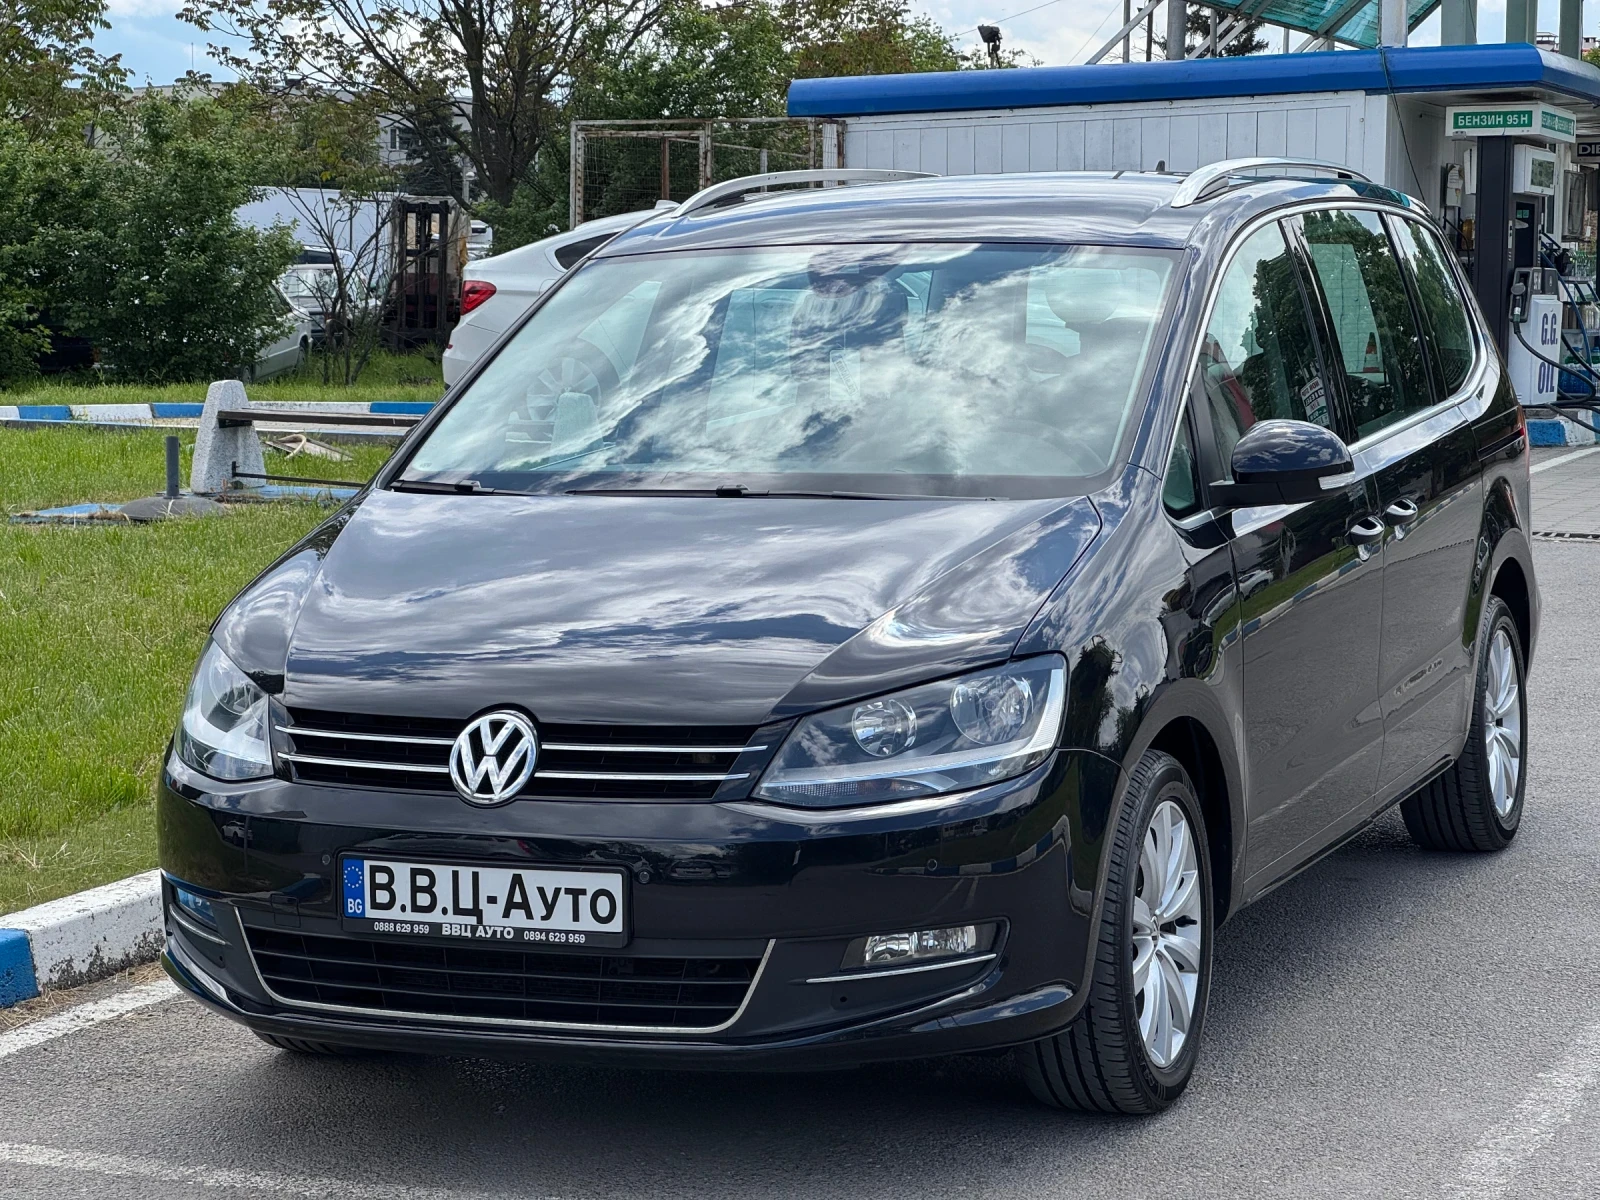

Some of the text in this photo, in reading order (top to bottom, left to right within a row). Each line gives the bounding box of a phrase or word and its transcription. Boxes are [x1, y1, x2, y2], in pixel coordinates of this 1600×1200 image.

[1458, 114, 1528, 126] БЕНЗИН 95 Н
[1541, 313, 1558, 346] G.G.
[1537, 361, 1555, 394] OIL
[455, 715, 533, 800] VW
[348, 899, 363, 914] BG
[369, 864, 617, 925] В.В.Ц-Ауто
[373, 922, 586, 943] 0888 629 959 ВВЦ АУТО 0894 629 959
